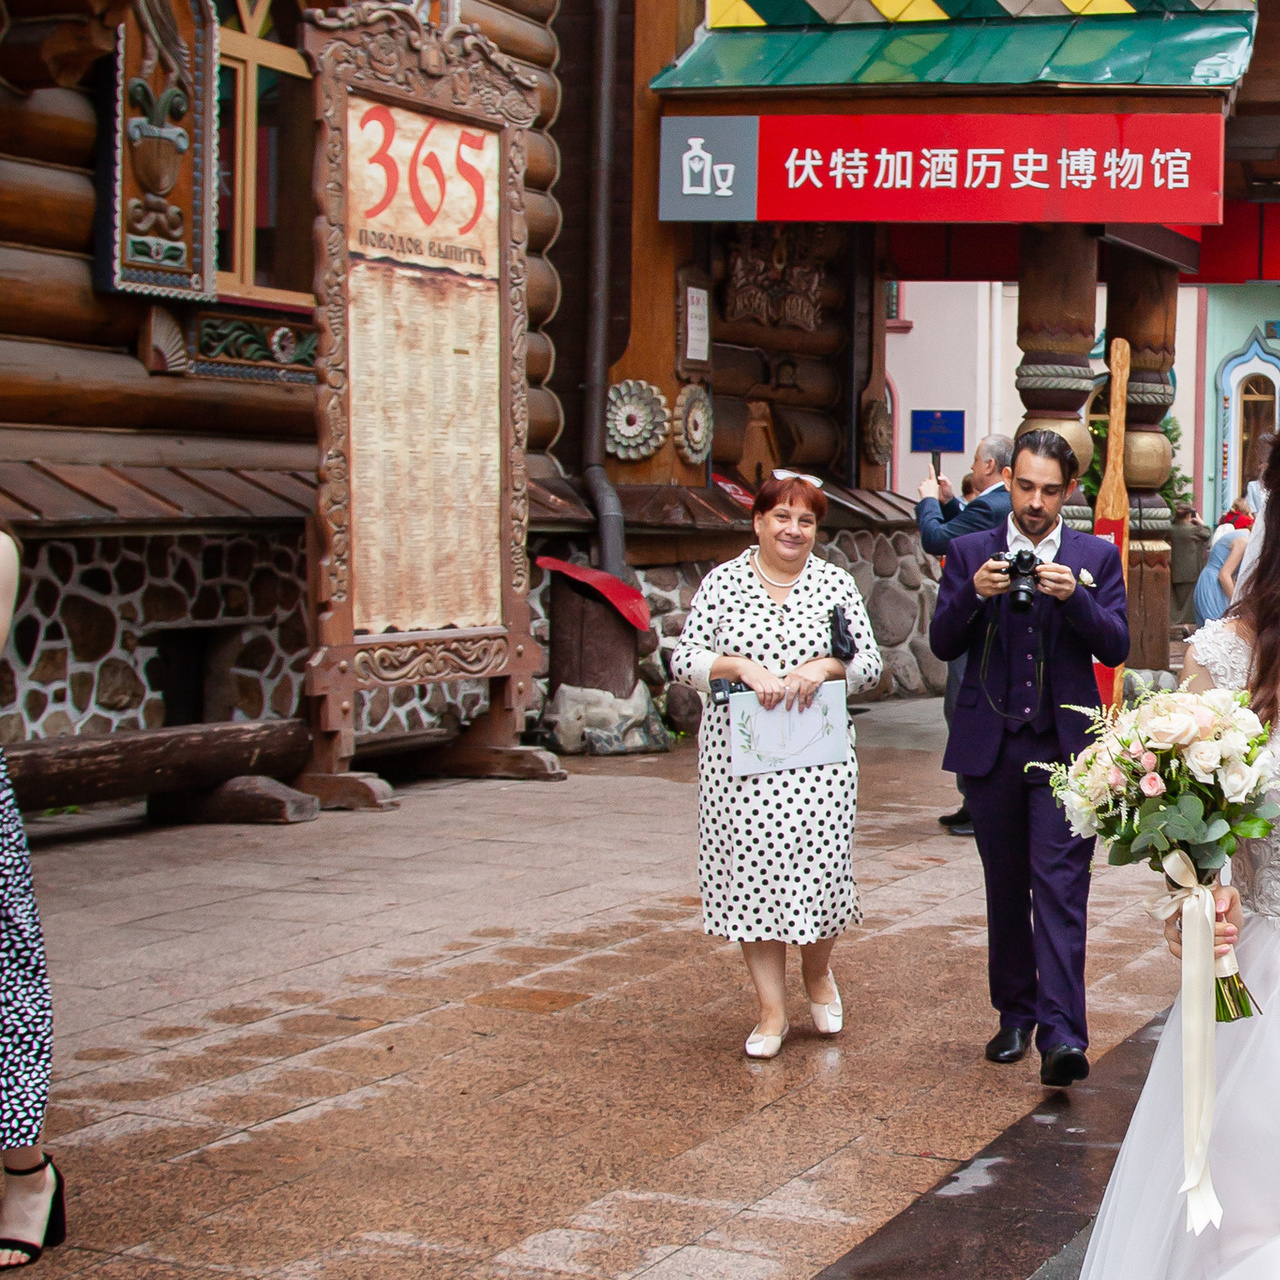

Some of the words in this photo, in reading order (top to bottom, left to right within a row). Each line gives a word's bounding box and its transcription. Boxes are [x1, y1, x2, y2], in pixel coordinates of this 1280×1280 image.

[360, 105, 486, 235] 365
[784, 147, 1192, 191] 伏特加酒历史博物馆
[358, 228, 423, 256] ПОВОДОВ
[428, 240, 486, 266] ВЫПИТЬ
